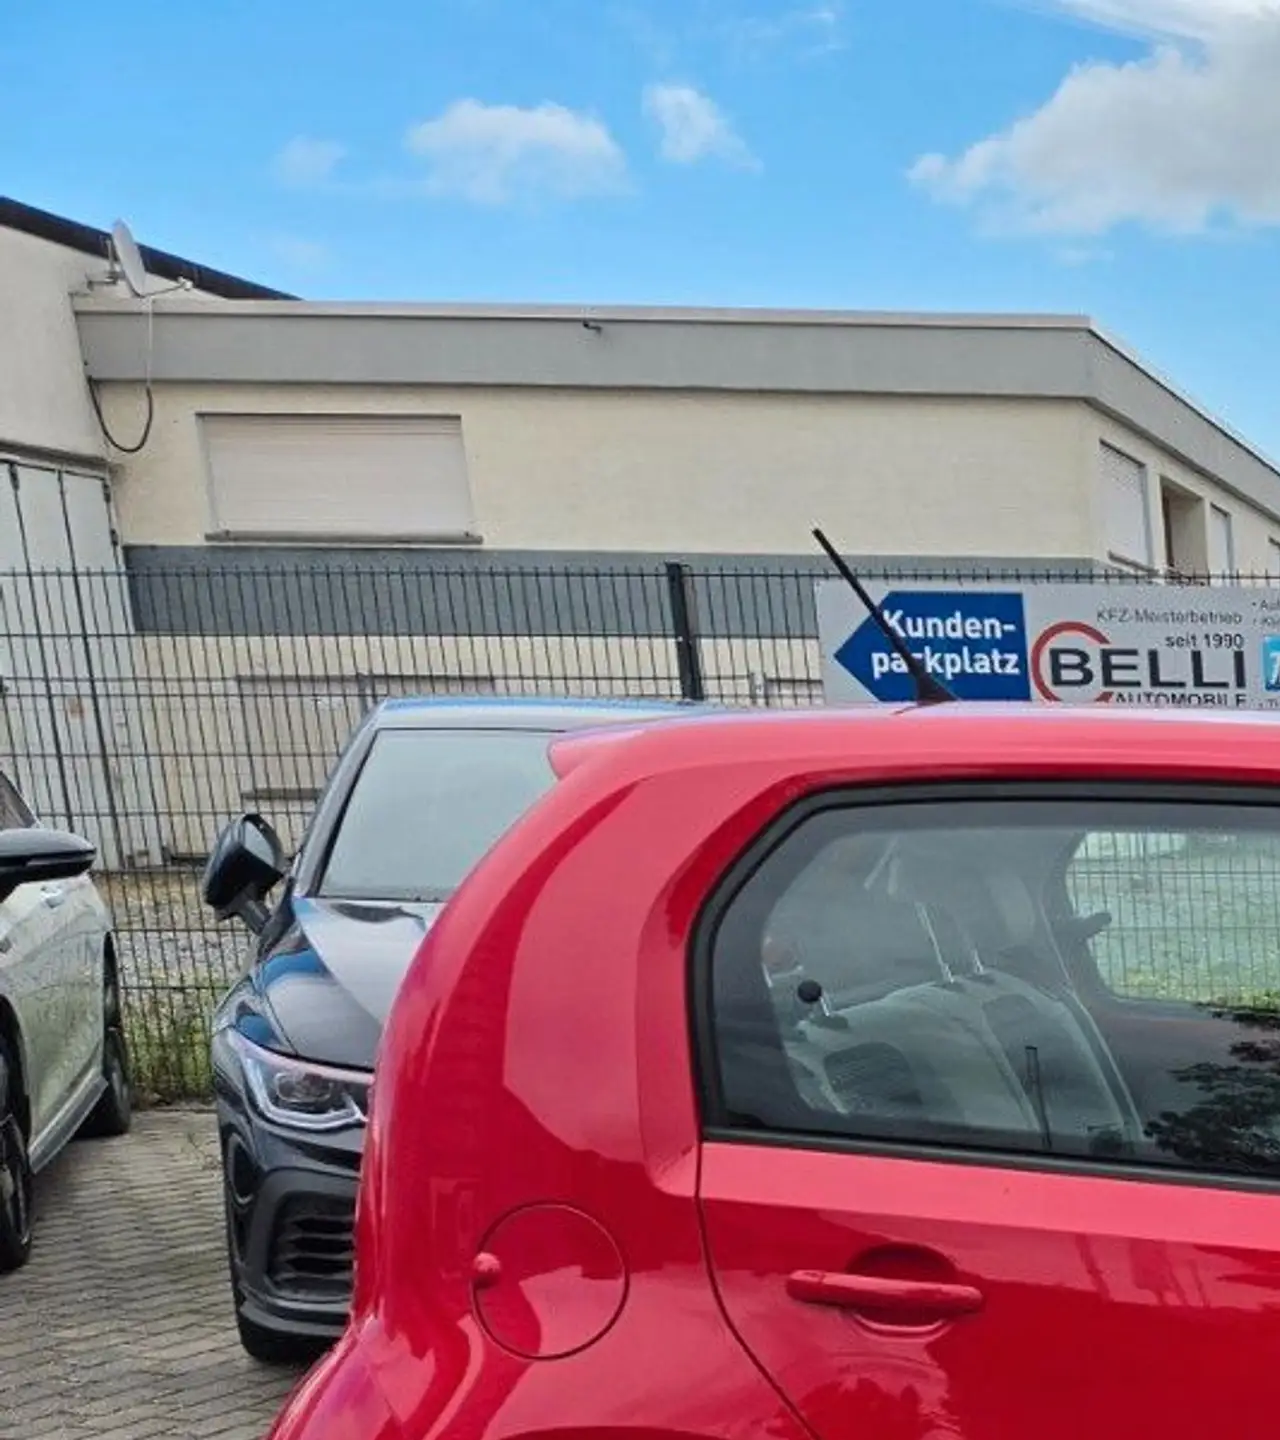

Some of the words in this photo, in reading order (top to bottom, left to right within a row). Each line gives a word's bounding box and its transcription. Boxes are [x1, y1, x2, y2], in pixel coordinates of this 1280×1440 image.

[882, 609, 1017, 640] Kunden-
[1097, 609, 1243, 625] KFZ-Meisterbetrieb
[1165, 634, 1197, 648] seit
[1204, 633, 1244, 649] 1990
